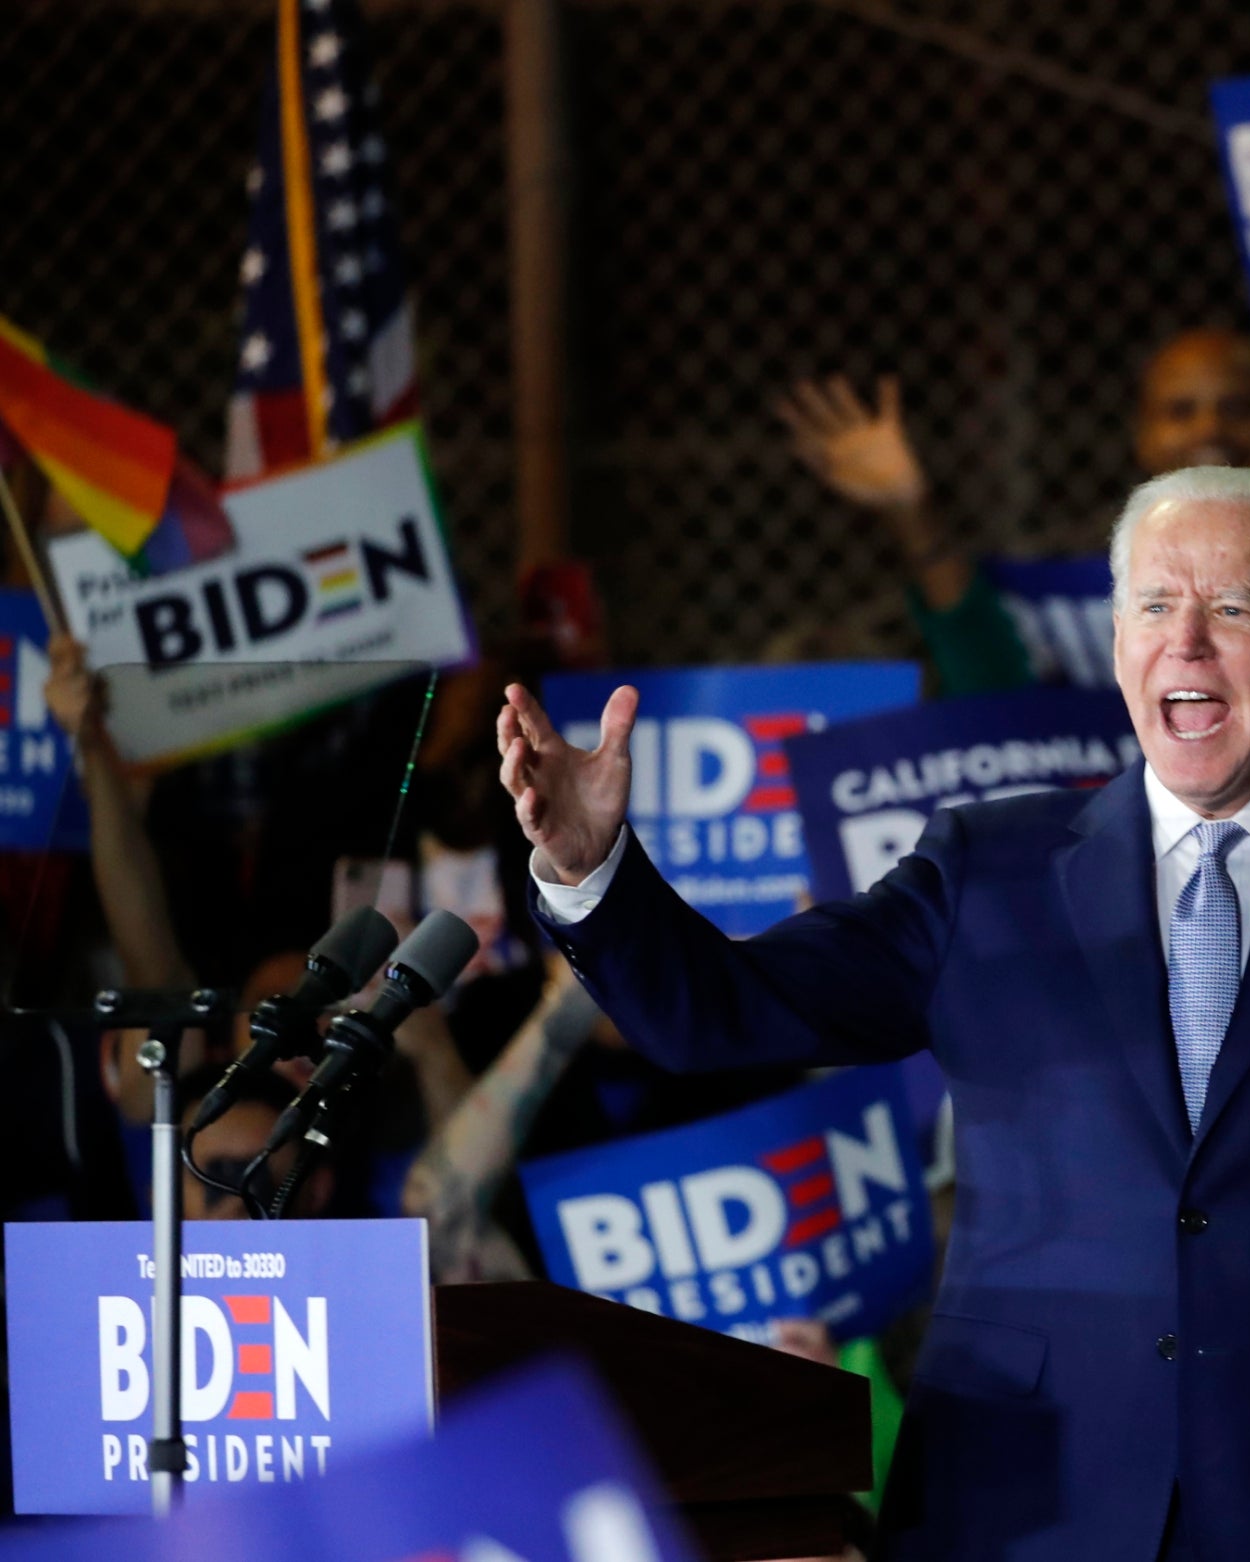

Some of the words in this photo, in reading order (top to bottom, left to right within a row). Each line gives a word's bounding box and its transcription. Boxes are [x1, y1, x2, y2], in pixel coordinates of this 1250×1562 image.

[135, 516, 431, 672] BIDEN
[831, 734, 1115, 813] CALIFORNIA
[557, 1101, 907, 1293] BIDEN
[137, 1254, 155, 1279] Te
[180, 1254, 226, 1279] NITED
[228, 1255, 242, 1279] to
[243, 1253, 286, 1279] 30330
[598, 1202, 912, 1322] RESIDENT
[98, 1295, 331, 1421] BDEN
[102, 1434, 332, 1483] PRSIDENT
